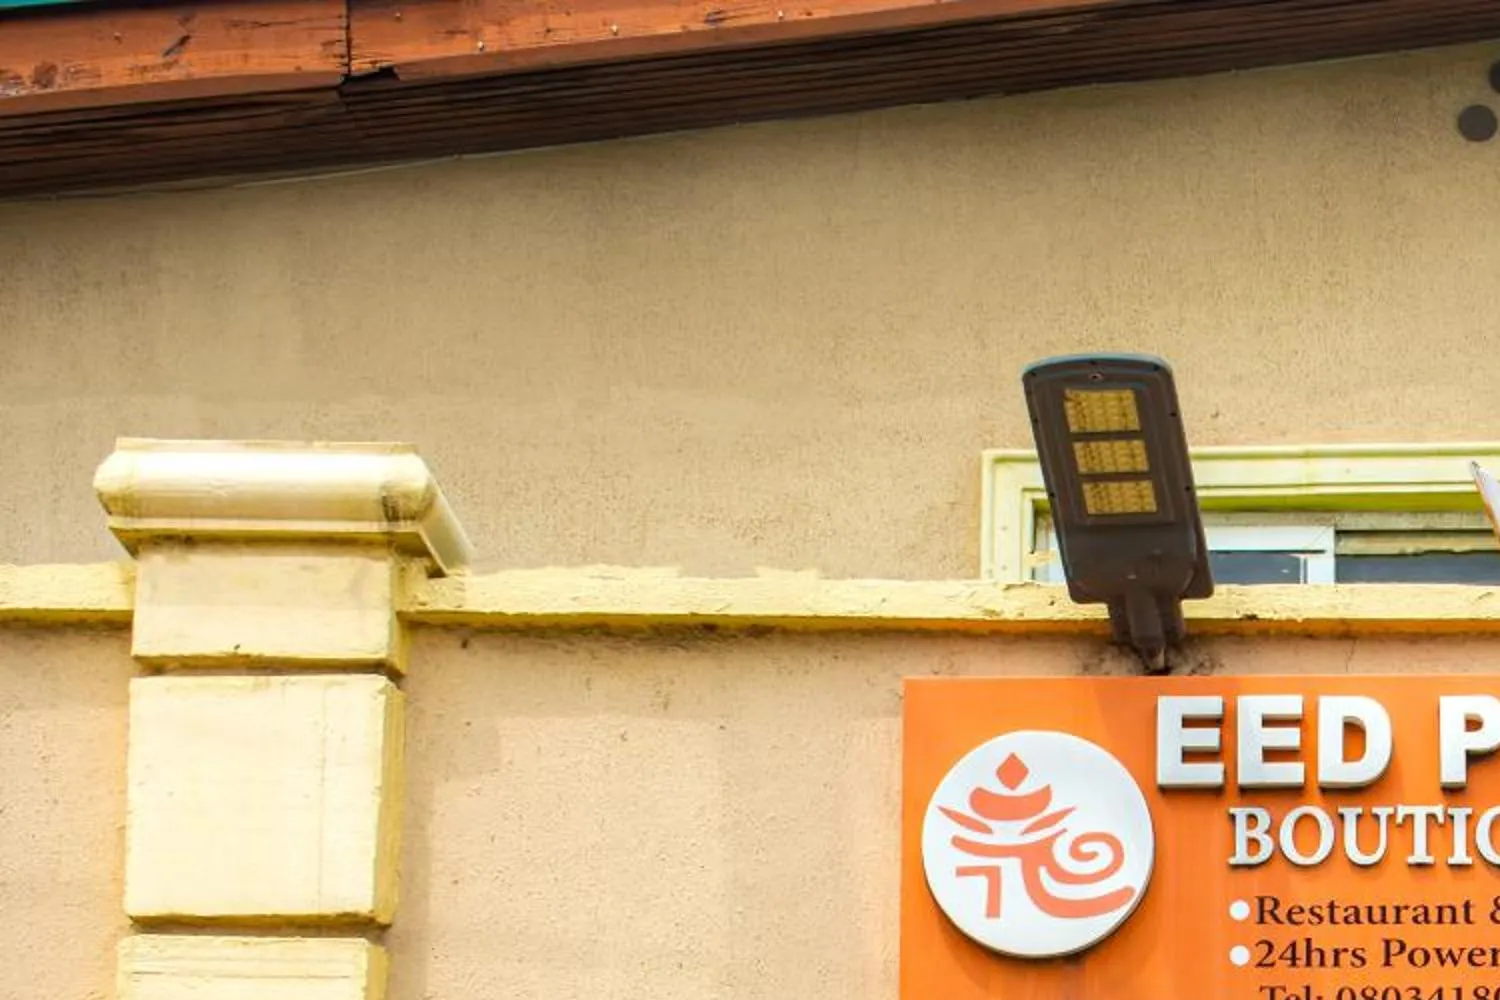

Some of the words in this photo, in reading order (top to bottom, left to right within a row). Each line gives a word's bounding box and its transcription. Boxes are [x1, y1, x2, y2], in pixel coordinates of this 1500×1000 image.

[1155, 694, 1393, 789] EED
[1254, 895, 1475, 925] Restaurant
[1254, 938, 1367, 968] 24hrs
